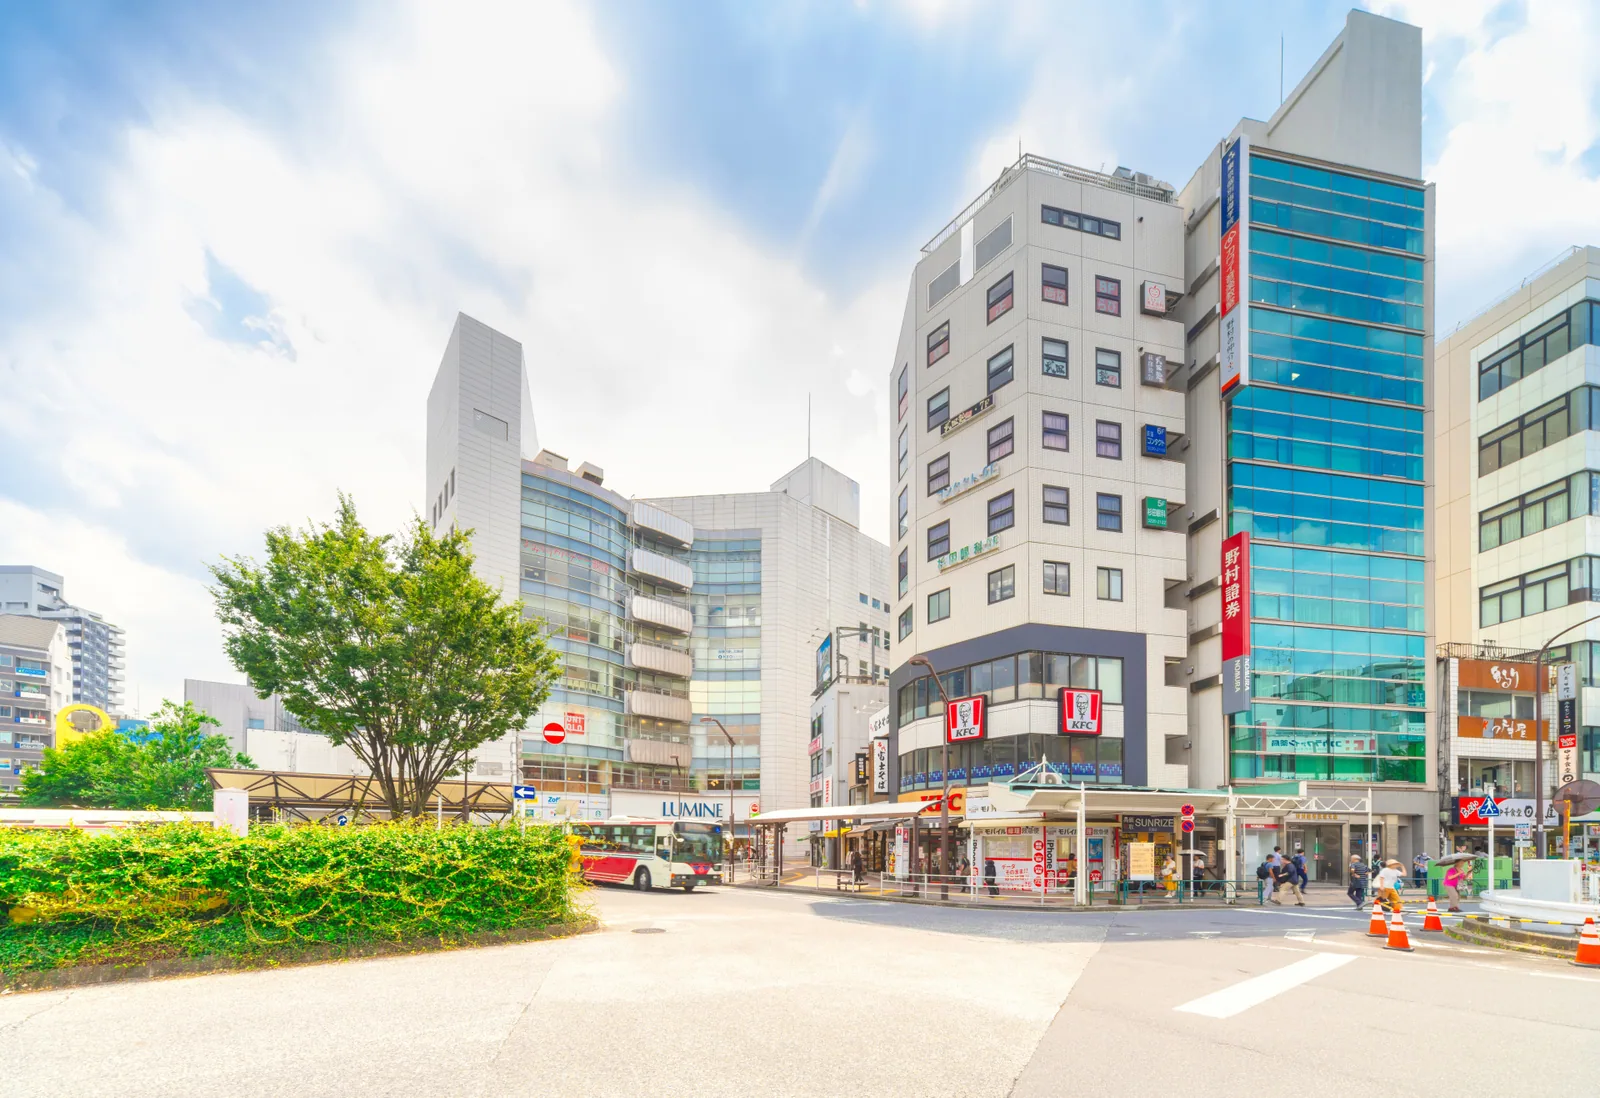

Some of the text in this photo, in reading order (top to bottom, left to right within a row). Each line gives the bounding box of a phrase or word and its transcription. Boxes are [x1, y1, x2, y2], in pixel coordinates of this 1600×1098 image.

[1225, 547, 1240, 620] 野村證券
[955, 727, 976, 737] KFC
[1072, 721, 1093, 730] KFC
[878, 751, 886, 789] 富士そば
[662, 801, 723, 818] LUMINE
[1524, 804, 1556, 819] 日屋
[1135, 818, 1174, 828] SUNRIZE
[1046, 840, 1055, 870] iPhone
